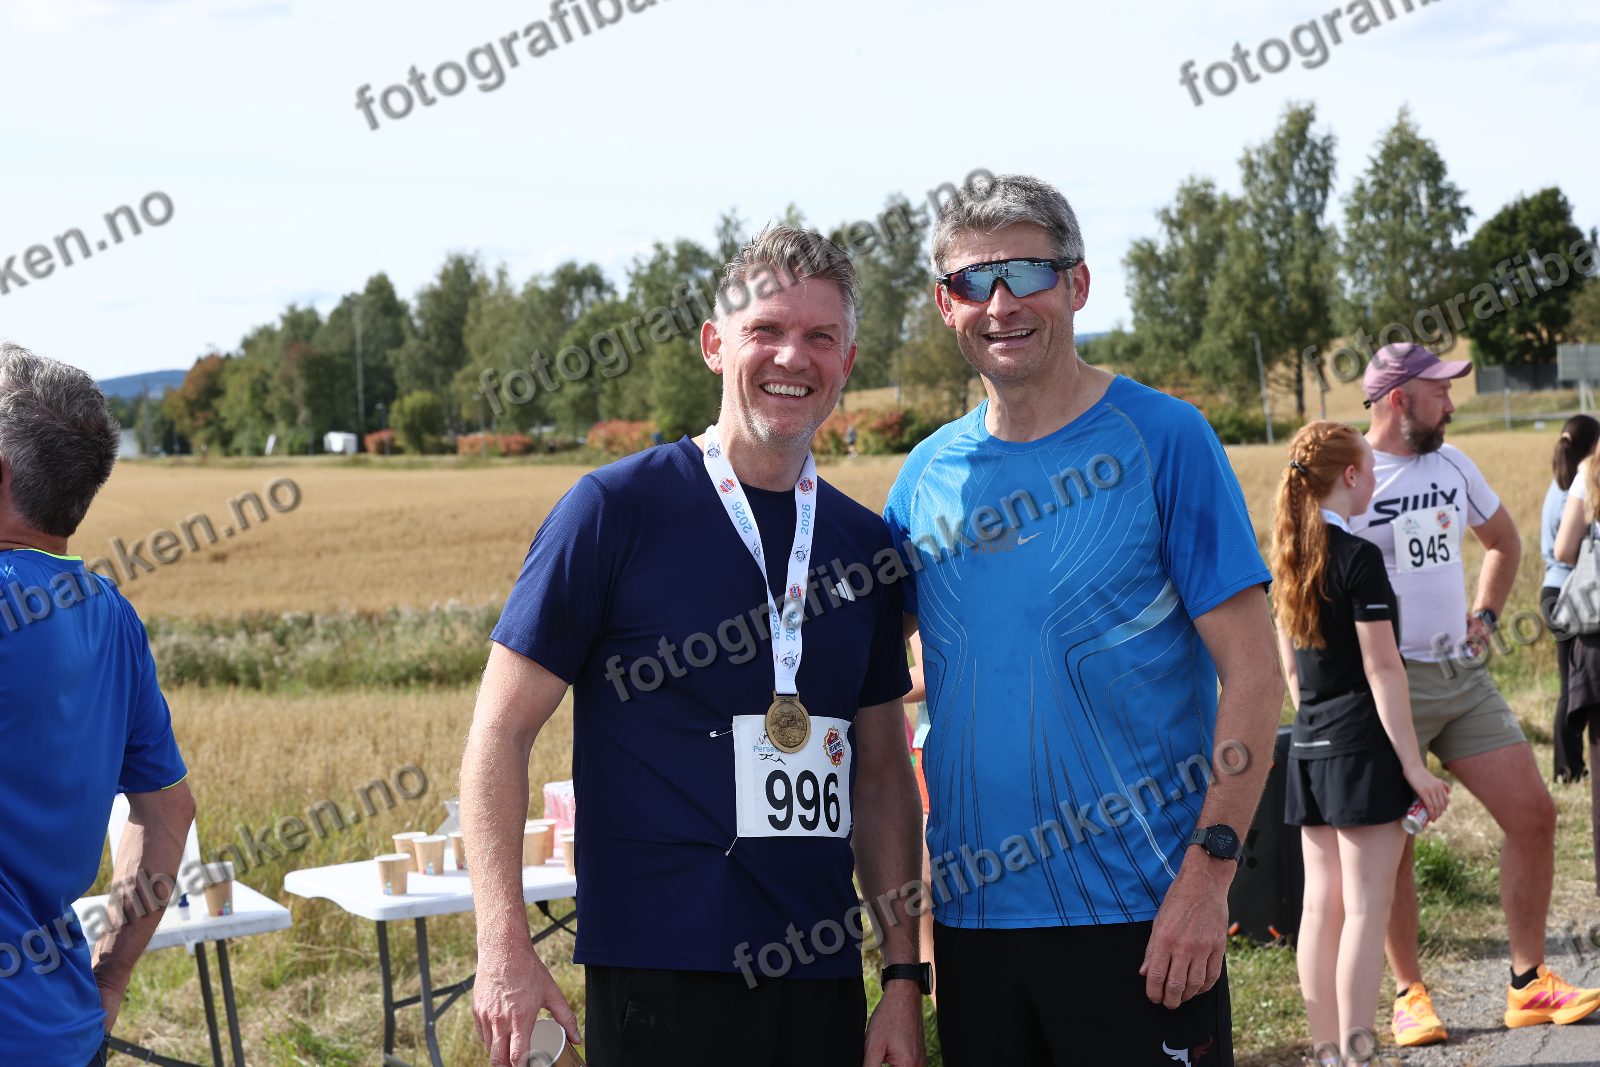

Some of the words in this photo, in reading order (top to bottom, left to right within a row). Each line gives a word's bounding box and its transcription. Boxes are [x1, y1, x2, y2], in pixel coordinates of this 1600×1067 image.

[731, 502, 752, 533] 2026
[801, 504, 811, 535] 2026
[1409, 534, 1450, 567] 945
[765, 769, 841, 832] 996
